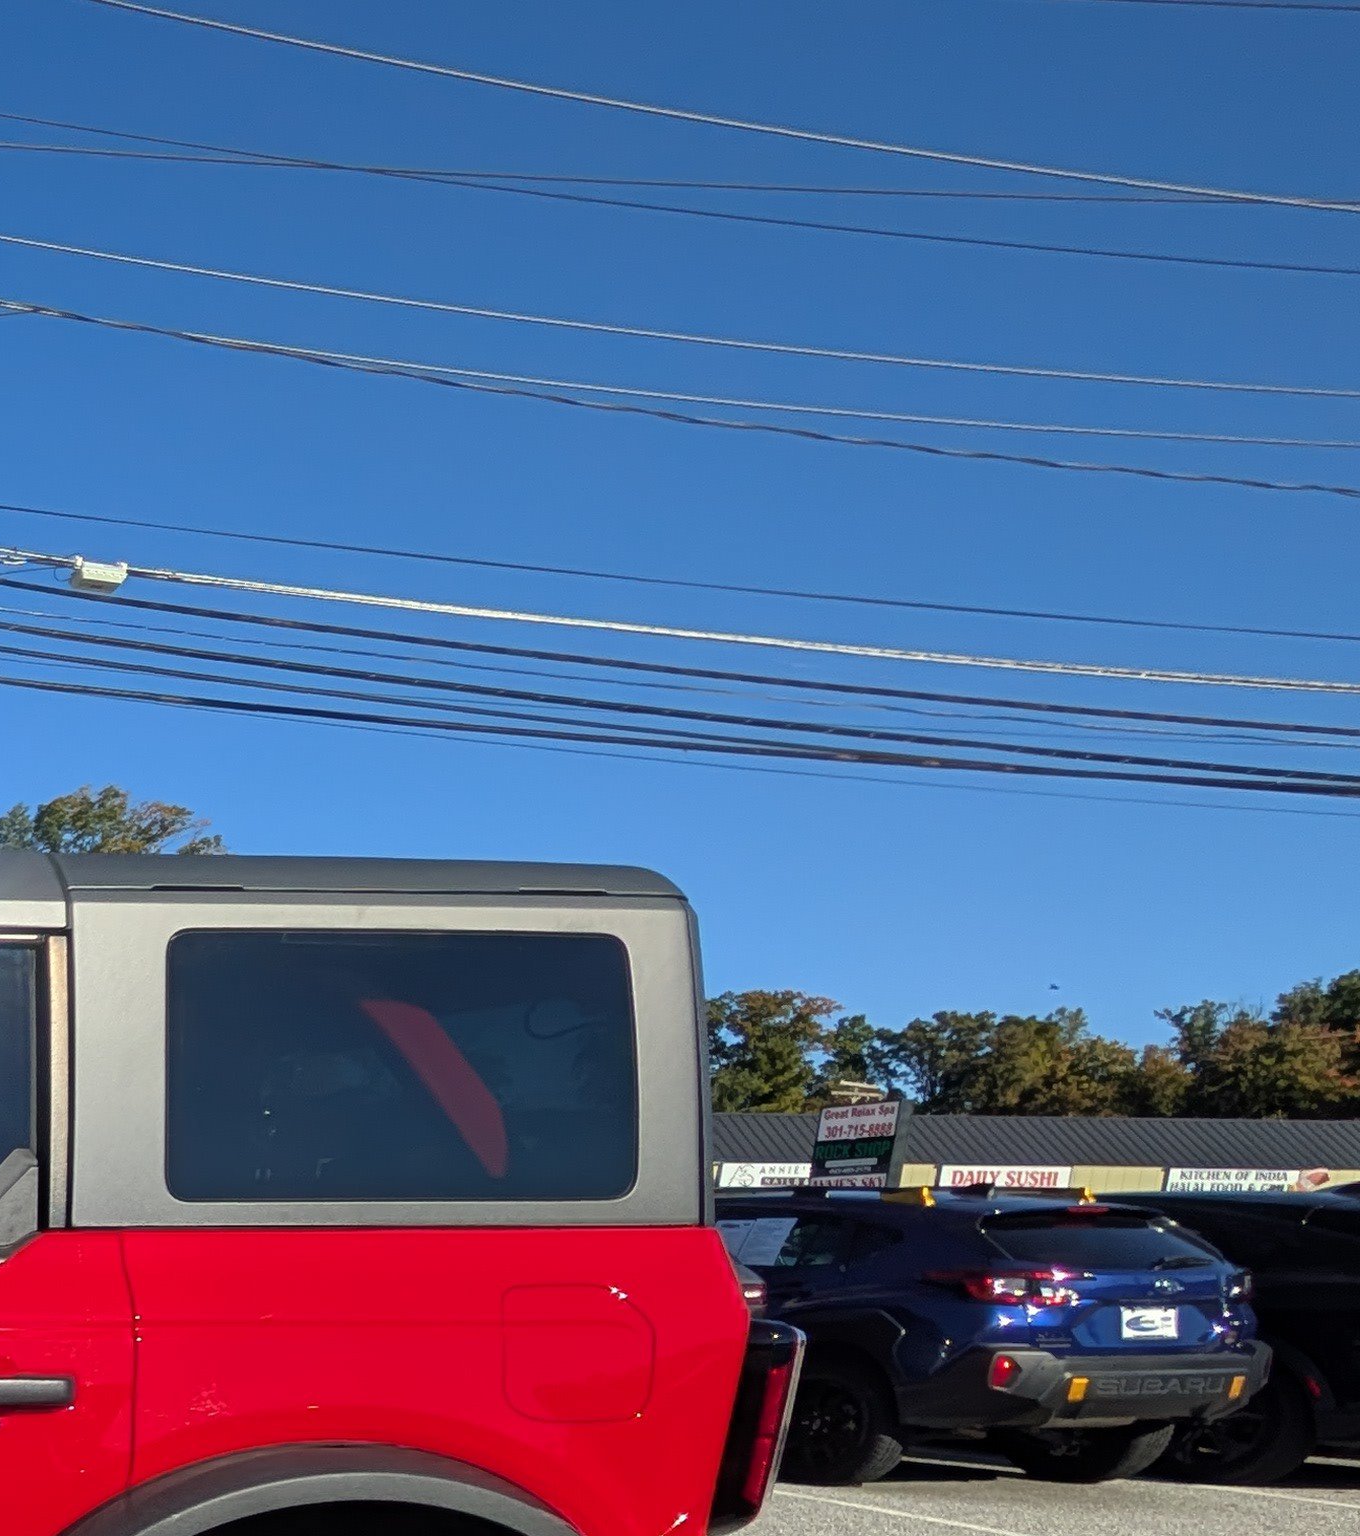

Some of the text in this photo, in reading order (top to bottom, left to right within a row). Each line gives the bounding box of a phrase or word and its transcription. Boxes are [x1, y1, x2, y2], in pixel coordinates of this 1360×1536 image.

[824, 1109, 850, 1120] Great
[878, 1105, 896, 1117] Spa
[816, 1145, 852, 1160] ROCK
[951, 1170, 1060, 1187] DAILY SUSHI
[1180, 1170, 1288, 1181] KITCHEN OF INDIA
[1096, 1377, 1226, 1395] SUBARU
